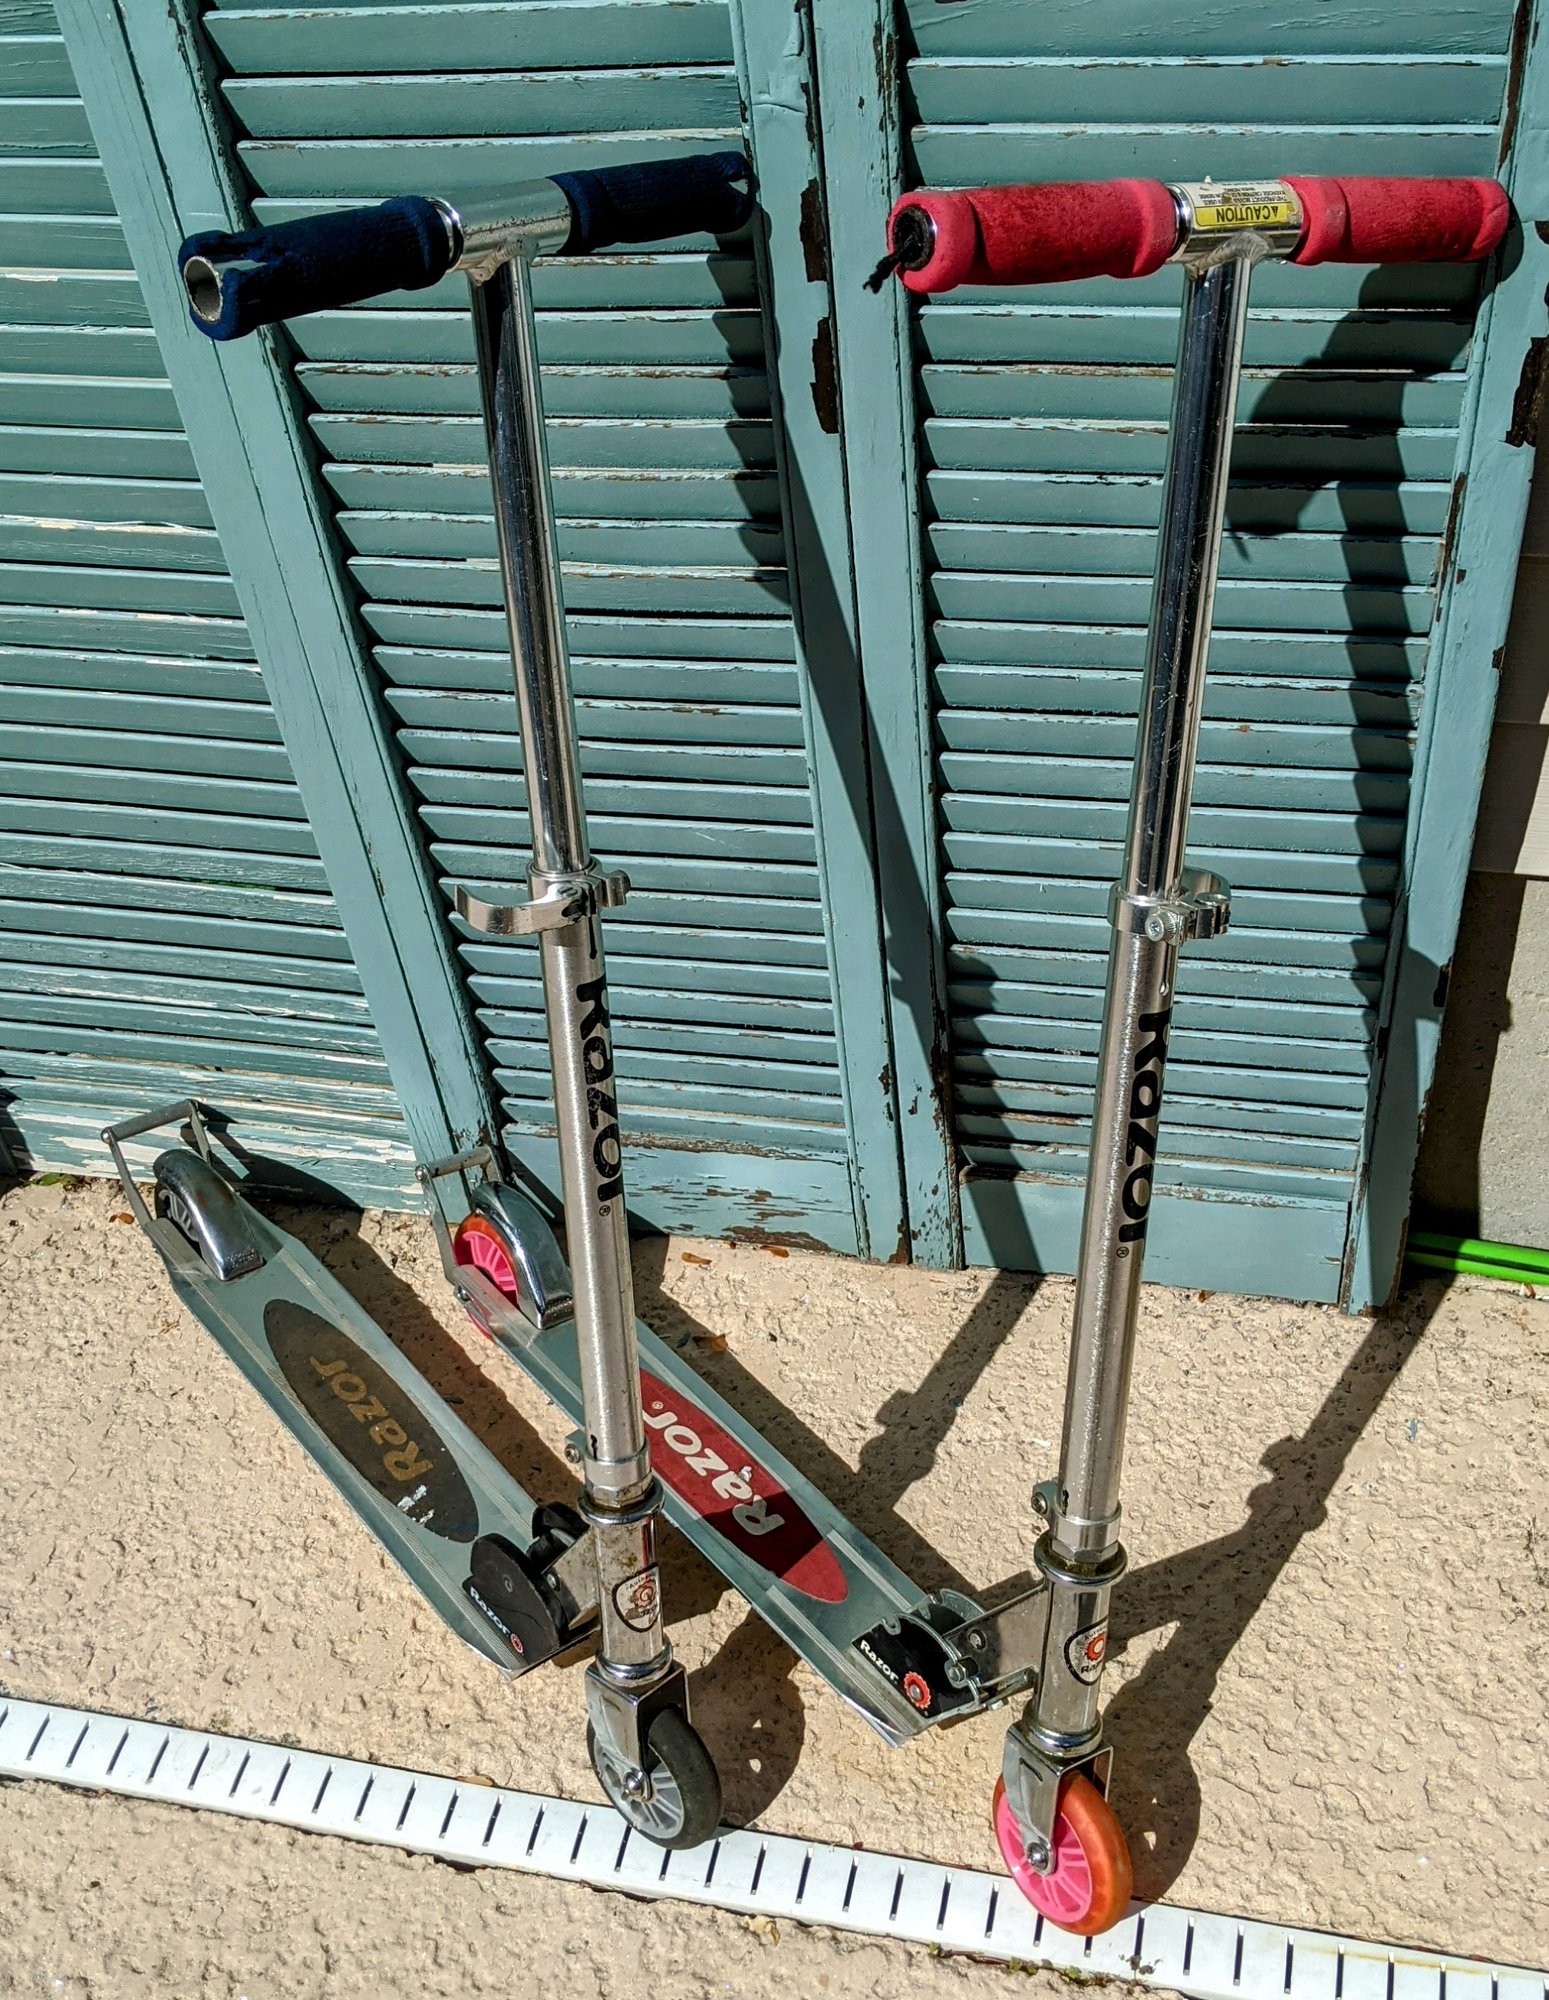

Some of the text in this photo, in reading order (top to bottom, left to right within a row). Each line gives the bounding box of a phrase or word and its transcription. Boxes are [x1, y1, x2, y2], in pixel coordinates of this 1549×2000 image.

[1216, 206, 1271, 222] CAUTION
[309, 1356, 434, 1481] Razor
[642, 1410, 786, 1536] Razor
[470, 1586, 511, 1635] Razor
[860, 1639, 899, 1681] Razor
